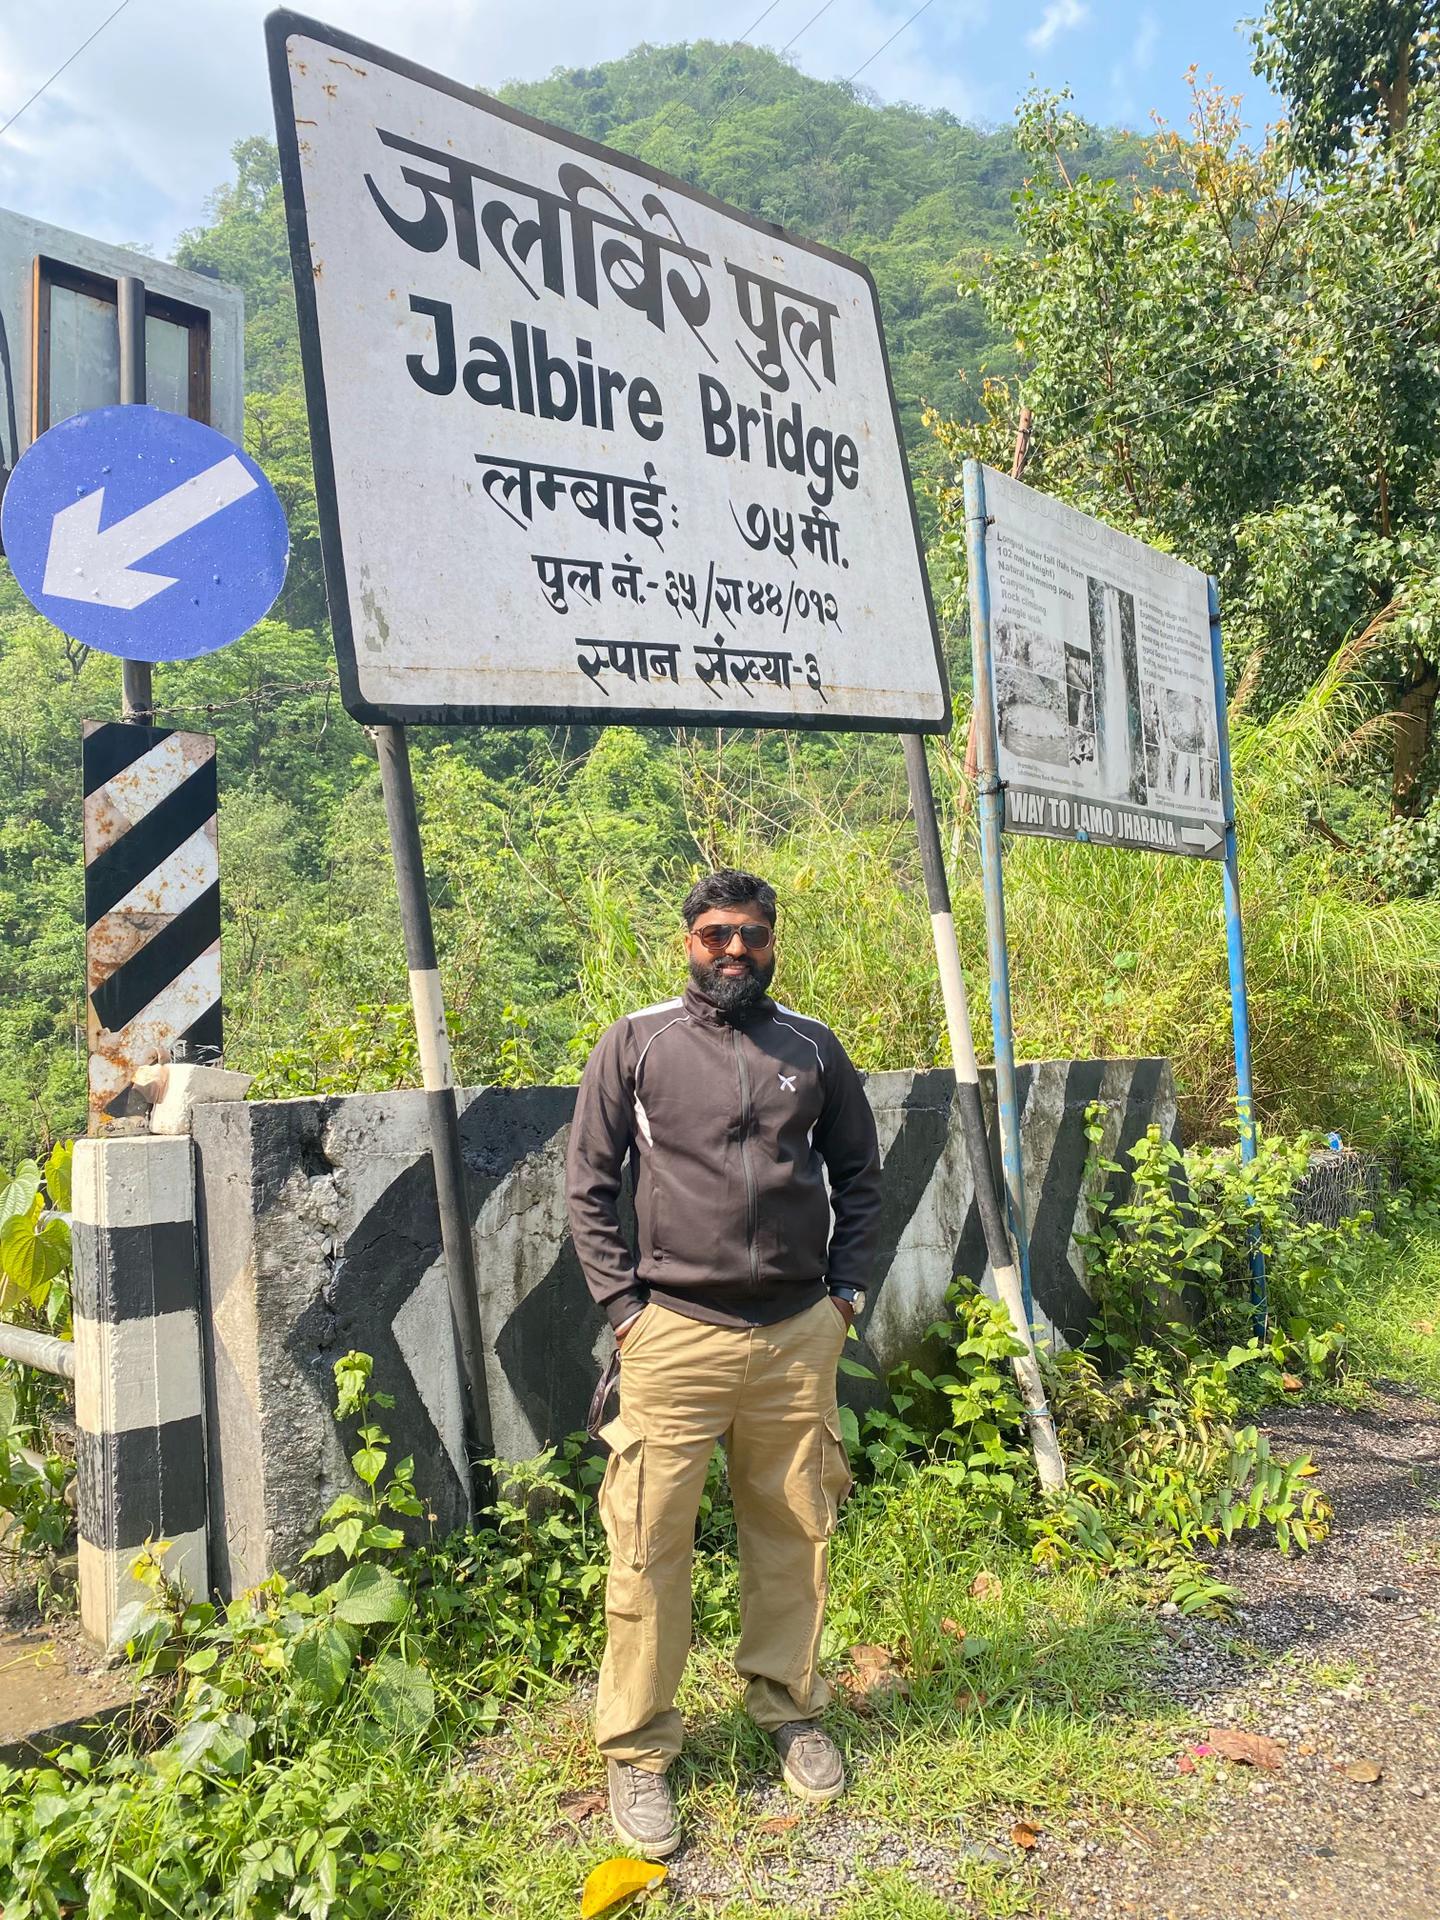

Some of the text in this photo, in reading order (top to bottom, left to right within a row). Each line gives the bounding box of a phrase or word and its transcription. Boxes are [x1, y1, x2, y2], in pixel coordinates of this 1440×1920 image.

[724, 259, 840, 393] पुल
[406, 294, 859, 506] Jalbire Bridge
[997, 546, 1012, 559] 102
[998, 560, 1025, 577] Natural
[1043, 553, 1055, 568] fall
[531, 554, 603, 615] पुल
[1001, 589, 1020, 602] Rock
[575, 638, 681, 696] स्पान
[1009, 791, 1046, 826] WAY
[1048, 798, 1071, 829] TO
[1073, 802, 1114, 838] LAMO
[1117, 810, 1177, 847] JHARANA
